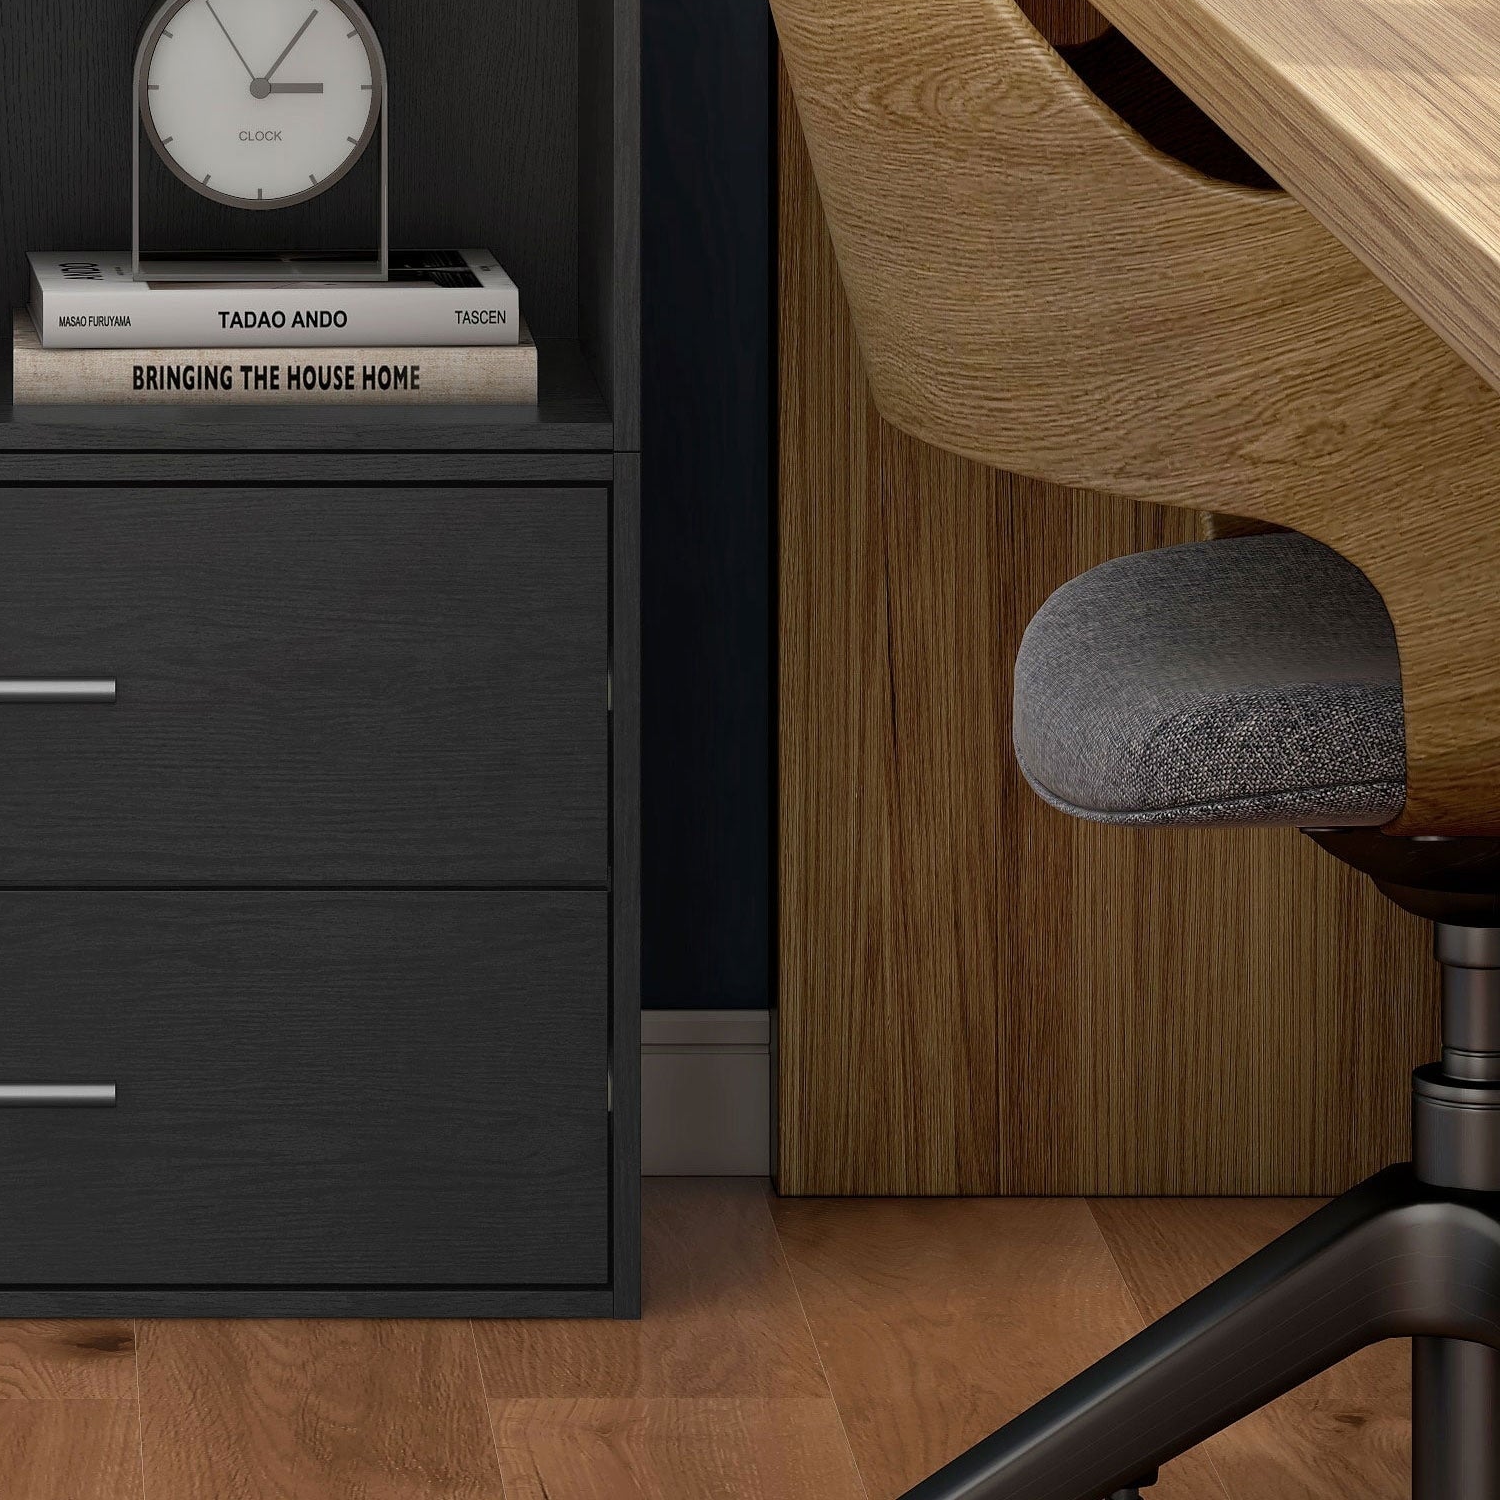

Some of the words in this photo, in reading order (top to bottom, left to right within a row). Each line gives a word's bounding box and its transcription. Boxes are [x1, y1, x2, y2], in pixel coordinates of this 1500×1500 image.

[238, 130, 282, 142] CLOCK
[58, 315, 87, 327] MASAO
[88, 315, 132, 327] FURUYAMA
[217, 310, 287, 329] TADAO
[290, 310, 348, 329] ANDO
[454, 310, 506, 325] TASCEN
[132, 365, 233, 391] BRINGING
[239, 365, 280, 391] THE
[287, 365, 355, 391] HOUSE
[362, 365, 420, 391] HOME
